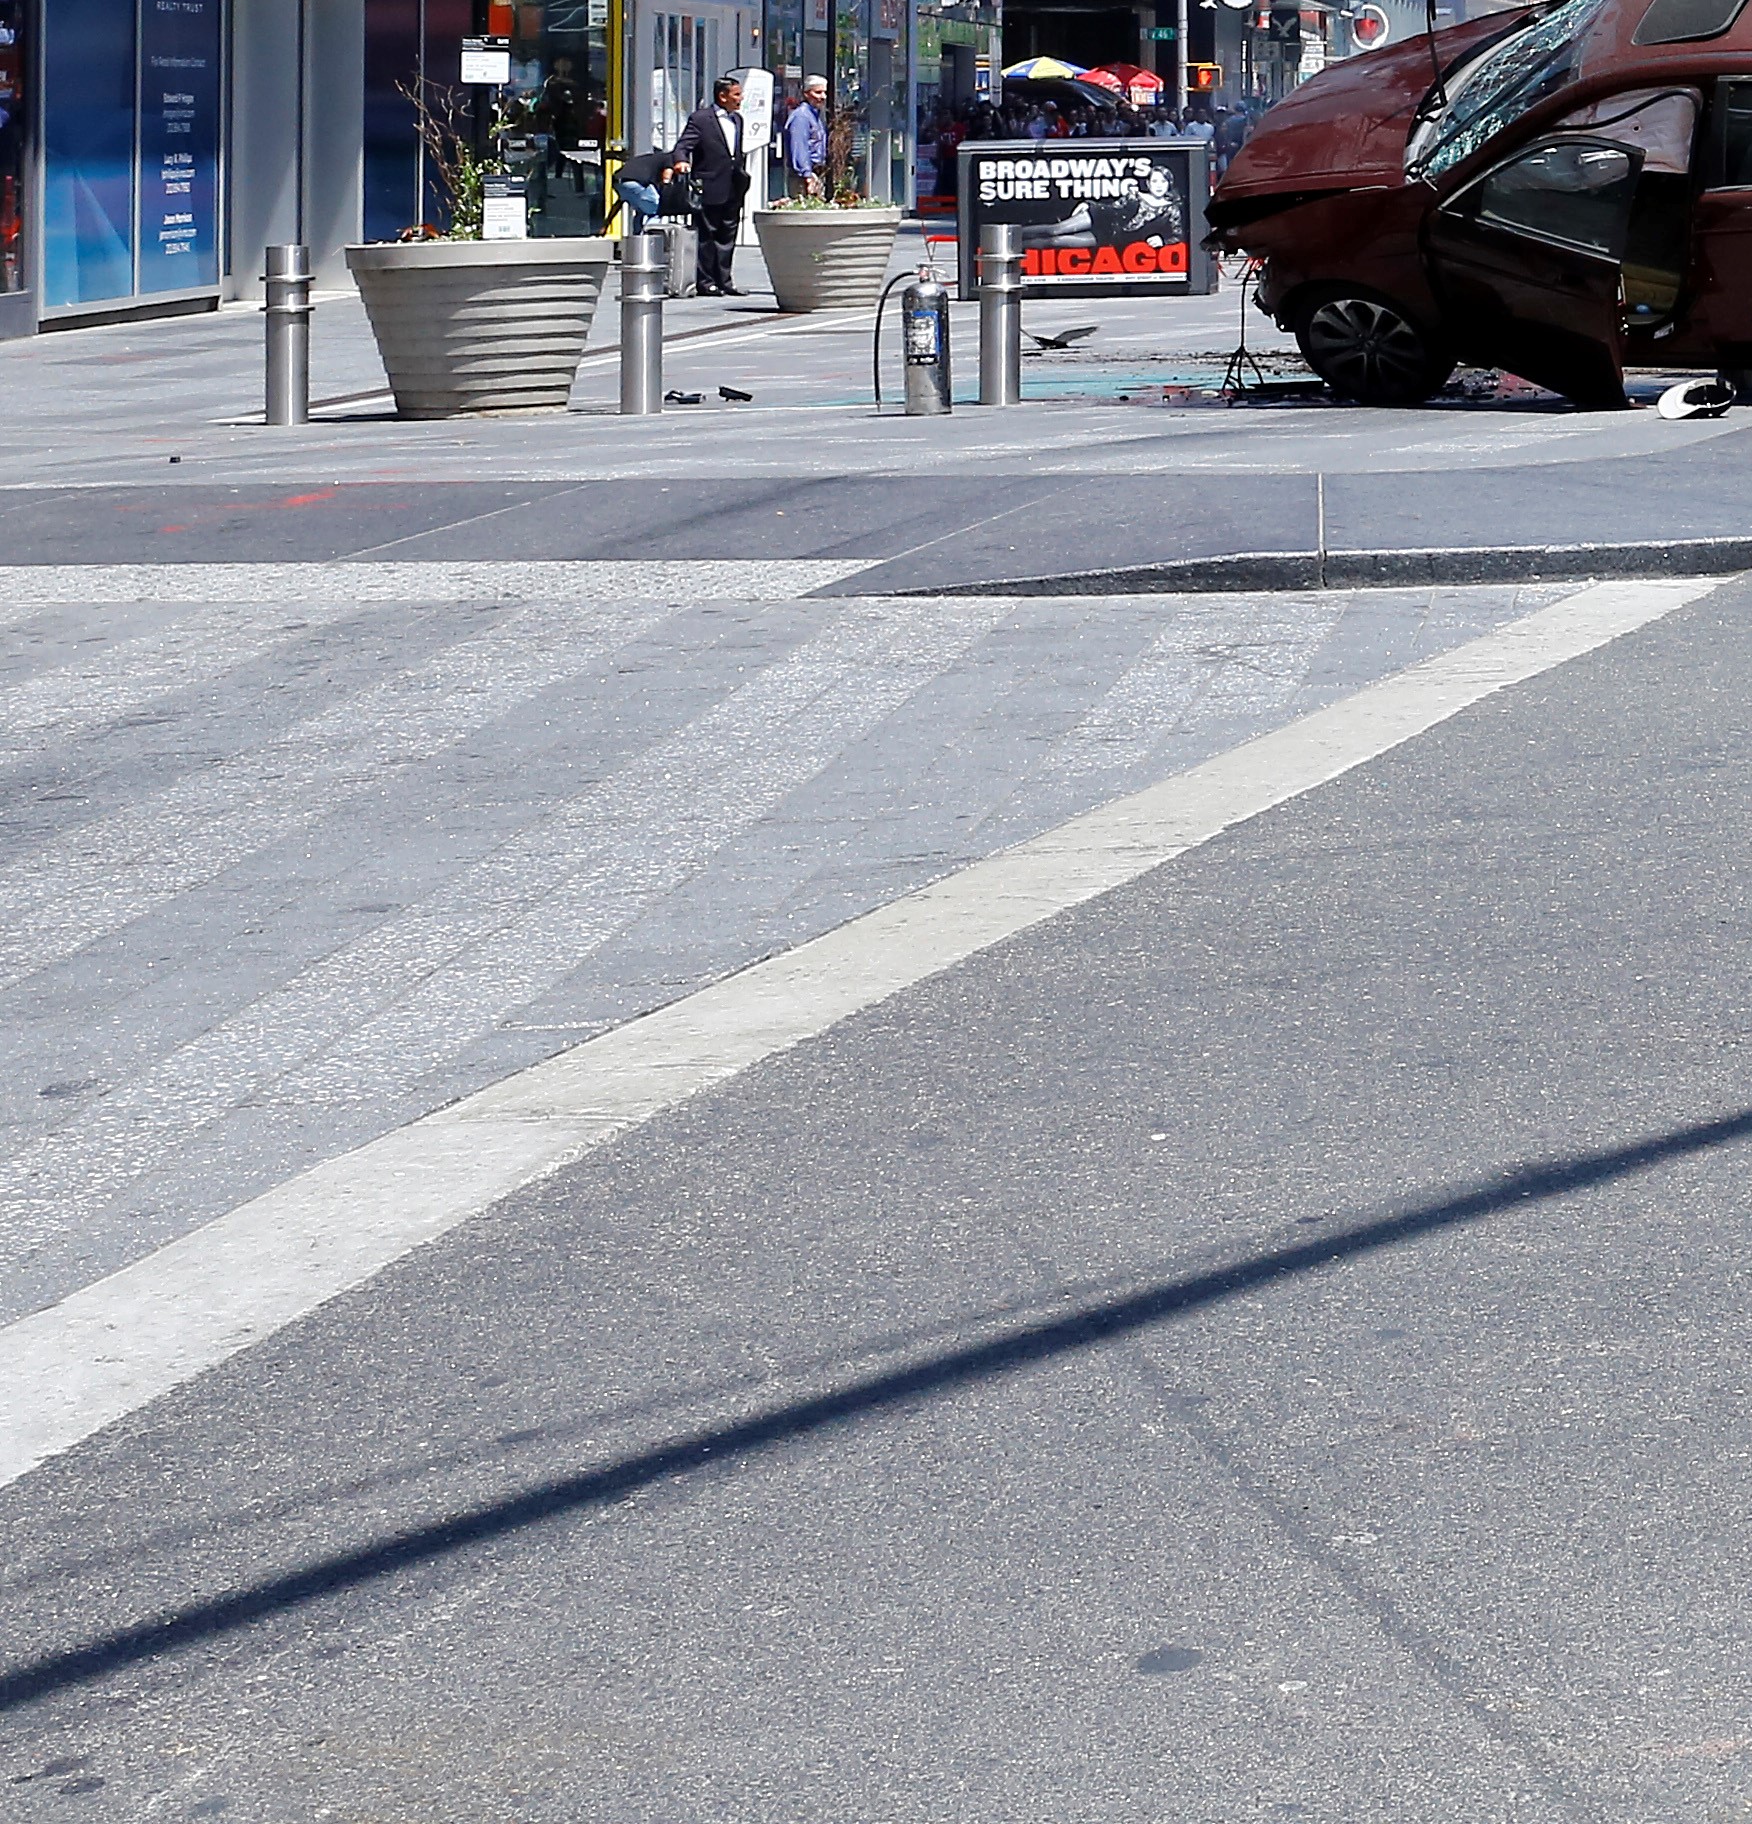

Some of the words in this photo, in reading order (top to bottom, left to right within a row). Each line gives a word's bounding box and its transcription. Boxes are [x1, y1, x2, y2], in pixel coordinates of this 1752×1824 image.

[156, 1, 180, 12] REALTY
[182, 2, 203, 13] TRUST
[979, 157, 1153, 180] BROADWAY'S
[979, 179, 1051, 201] SURE
[1055, 177, 1139, 199] THING
[1018, 241, 1188, 276] HICAGO
